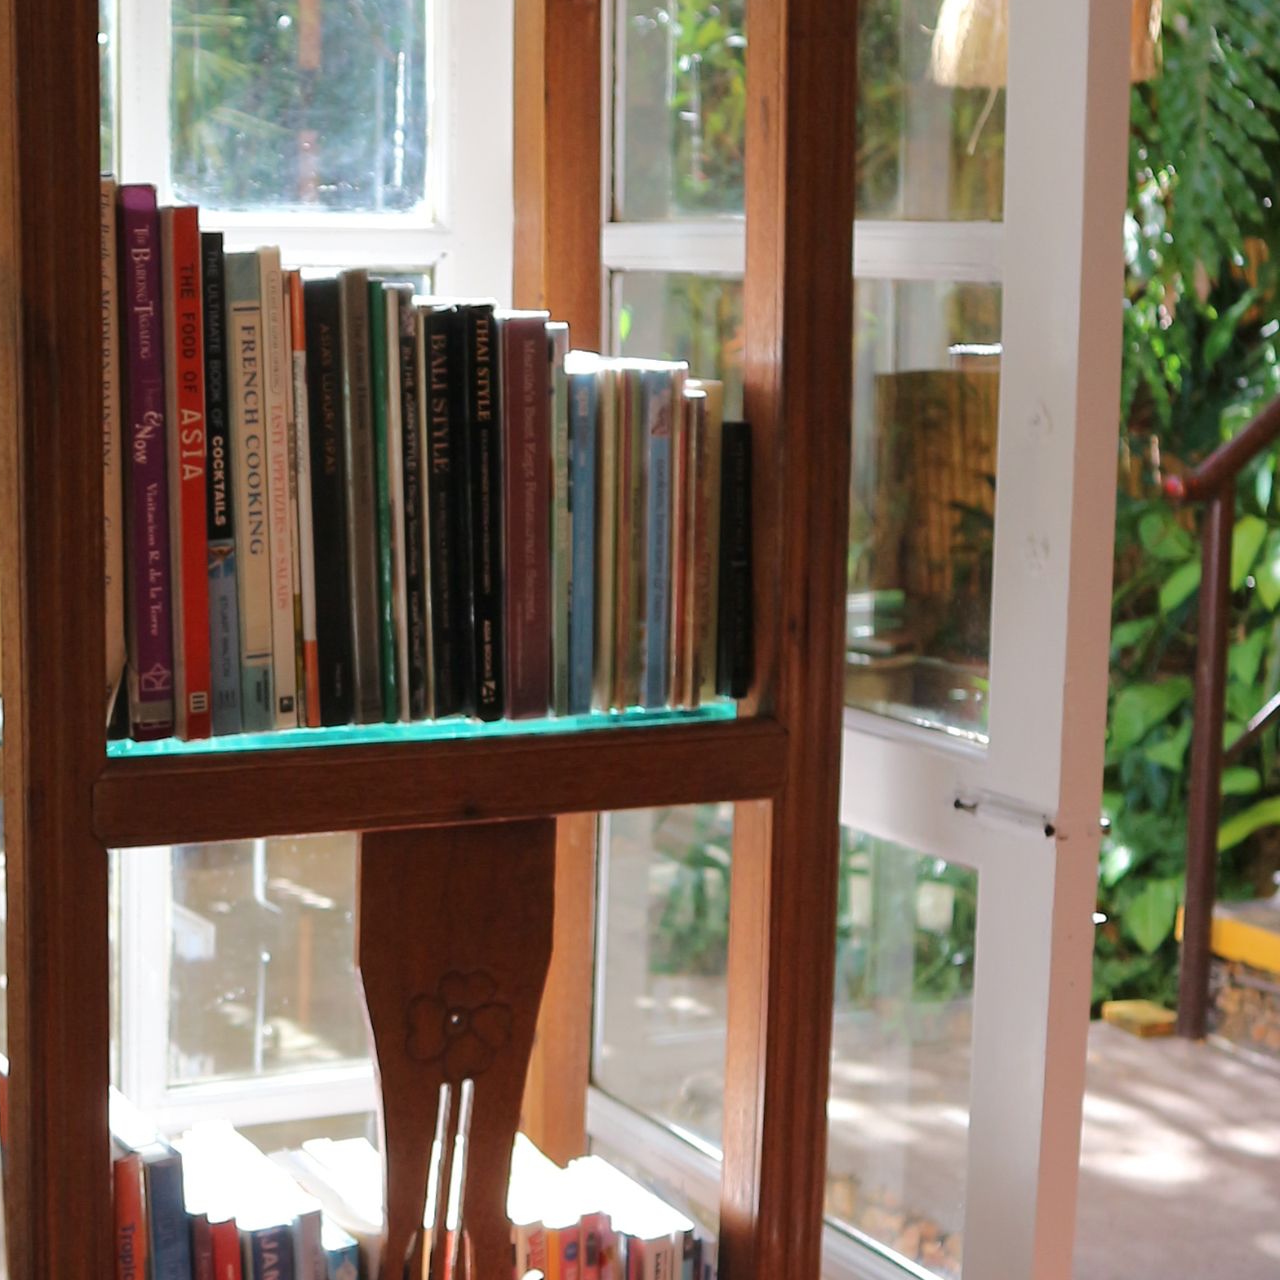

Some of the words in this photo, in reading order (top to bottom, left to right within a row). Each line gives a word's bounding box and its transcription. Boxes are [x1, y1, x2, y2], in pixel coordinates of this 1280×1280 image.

[180, 264, 194, 297] THE
[207, 250, 219, 277] THE
[182, 312, 196, 359] FOOD
[208, 284, 221, 354] ULTIMATE
[475, 319, 490, 362] THAI
[183, 372, 198, 394] OF
[209, 360, 222, 402] BOOK
[241, 325, 260, 425] FRENCH
[431, 334, 449, 391] BALI
[212, 408, 223, 427] OF
[477, 367, 491, 422] STYLE
[181, 408, 203, 481] ASIA
[271, 403, 284, 444] TASTY
[432, 398, 450, 474] STYLE
[212, 436, 226, 526] COCKTAILS
[245, 434, 265, 555] COOKING
